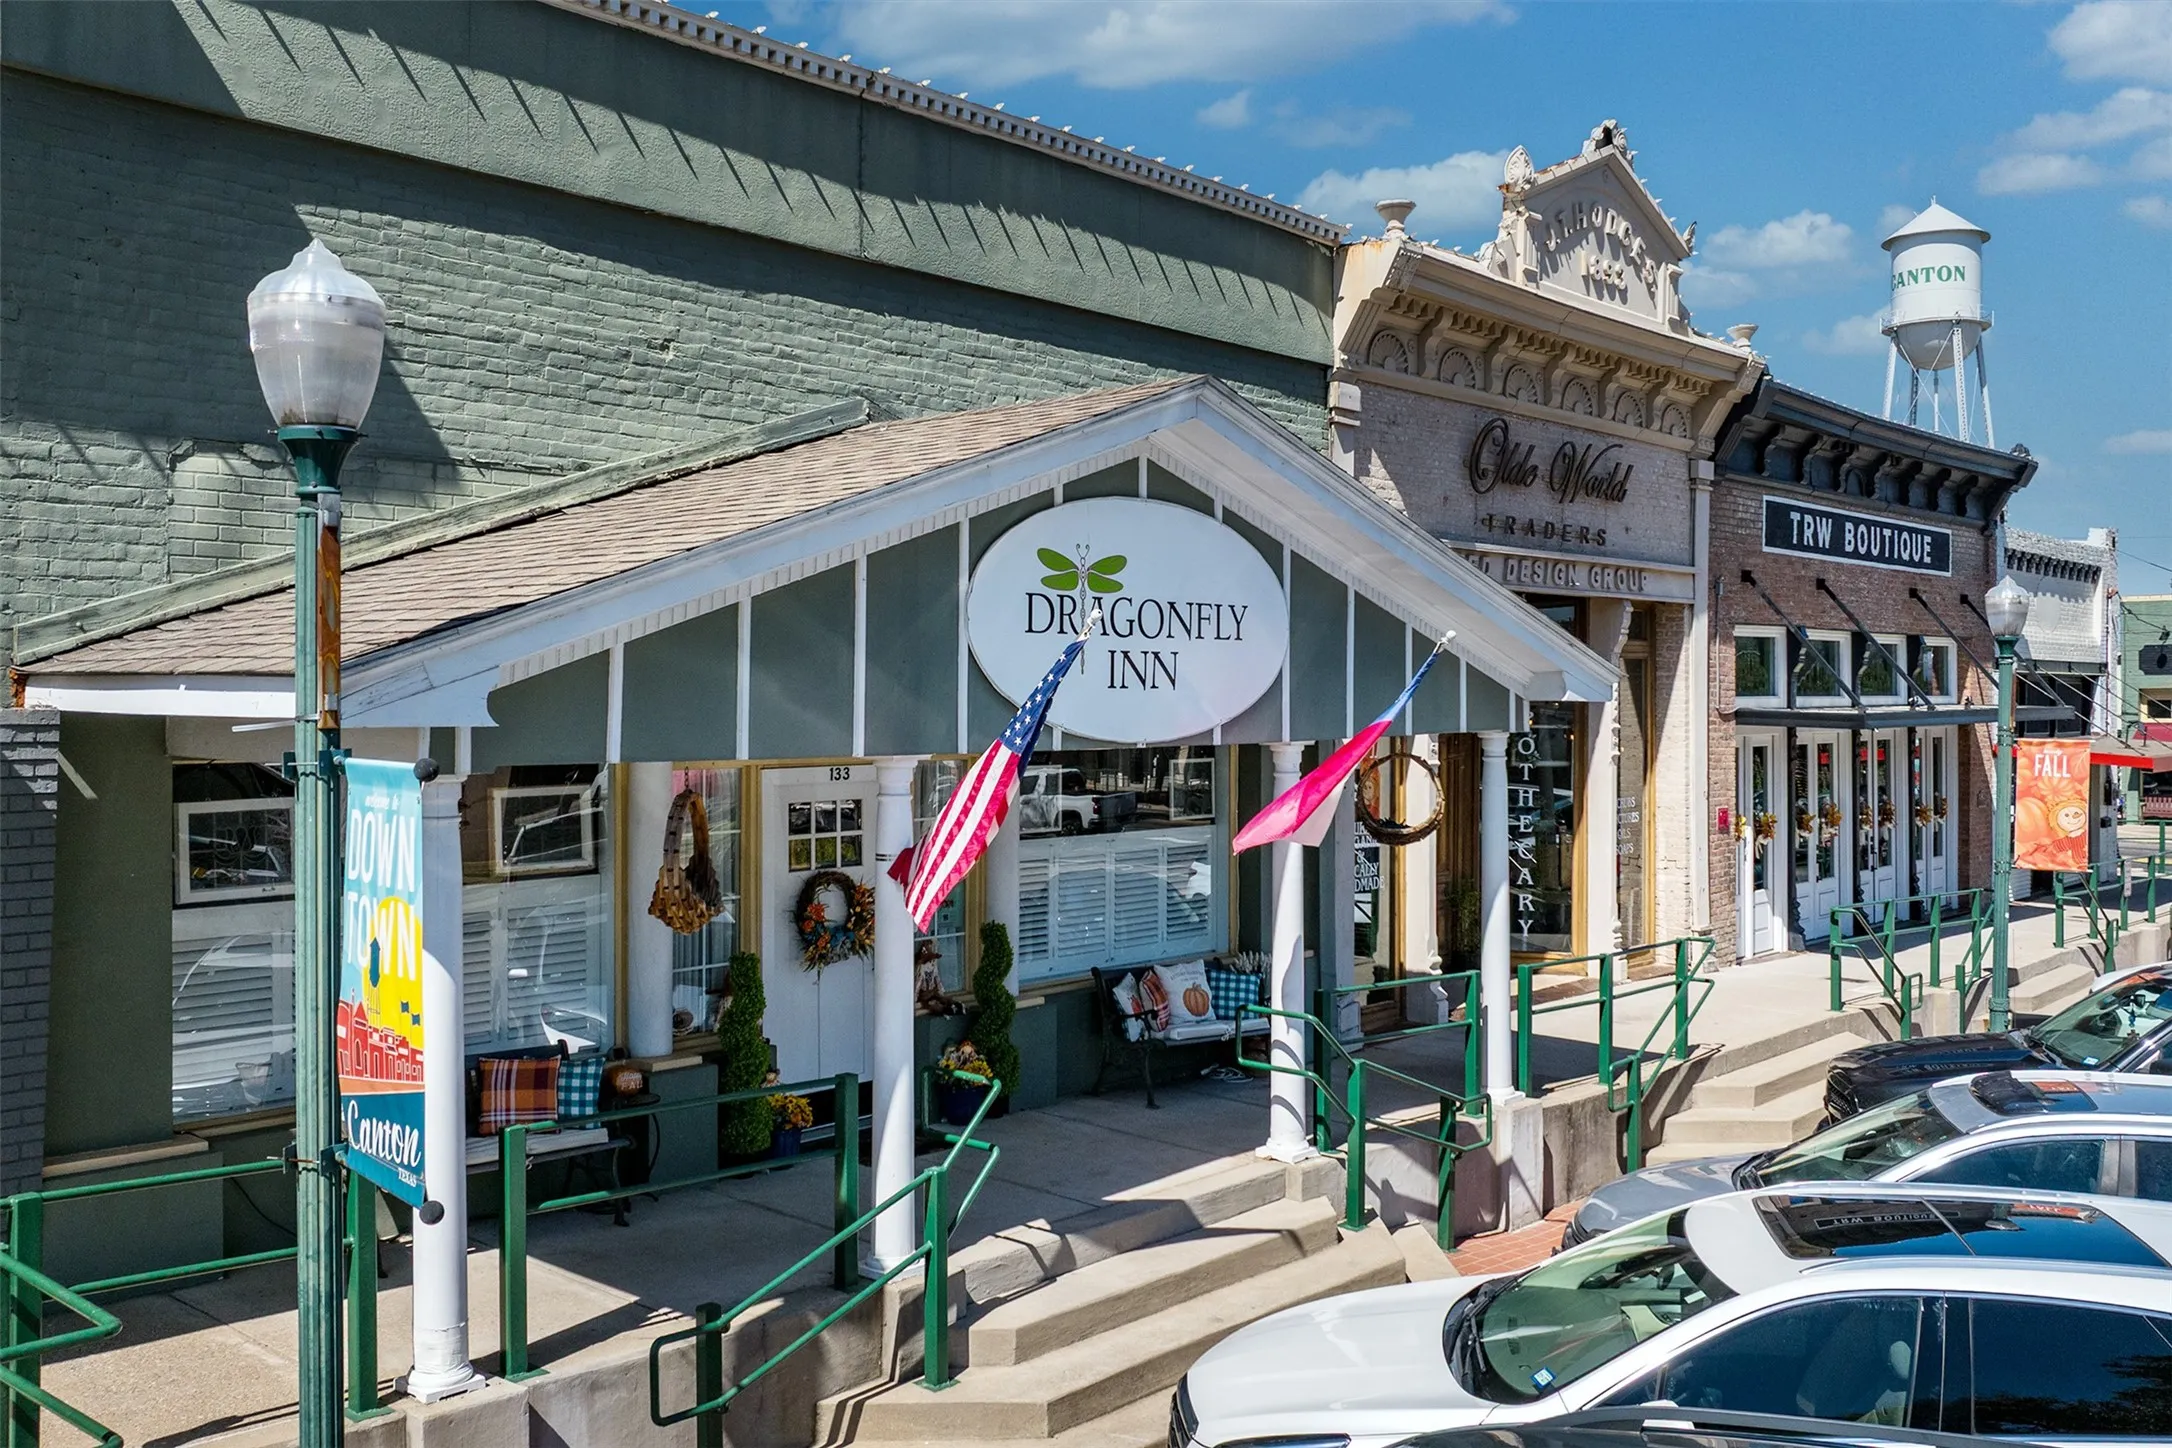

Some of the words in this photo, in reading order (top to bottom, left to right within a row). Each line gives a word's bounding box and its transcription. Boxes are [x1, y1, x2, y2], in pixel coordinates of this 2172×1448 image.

[1469, 417, 1540, 495] Olde
[1550, 440, 1635, 504] World
[1486, 512, 1608, 547] TRADERS
[1790, 511, 1833, 549] TRW
[1844, 521, 1932, 564] BOUTIQUE
[1504, 558, 1579, 587] DESIGN
[1589, 566, 1649, 593] GROUP
[1024, 592, 1249, 641] DRAGONFLY
[1107, 649, 1179, 691] INN
[829, 766, 850, 782] 133
[2033, 753, 2072, 778] FALL
[347, 808, 416, 893] DOWN
[347, 891, 416, 982] TOWN
[347, 1099, 422, 1168] Canton
